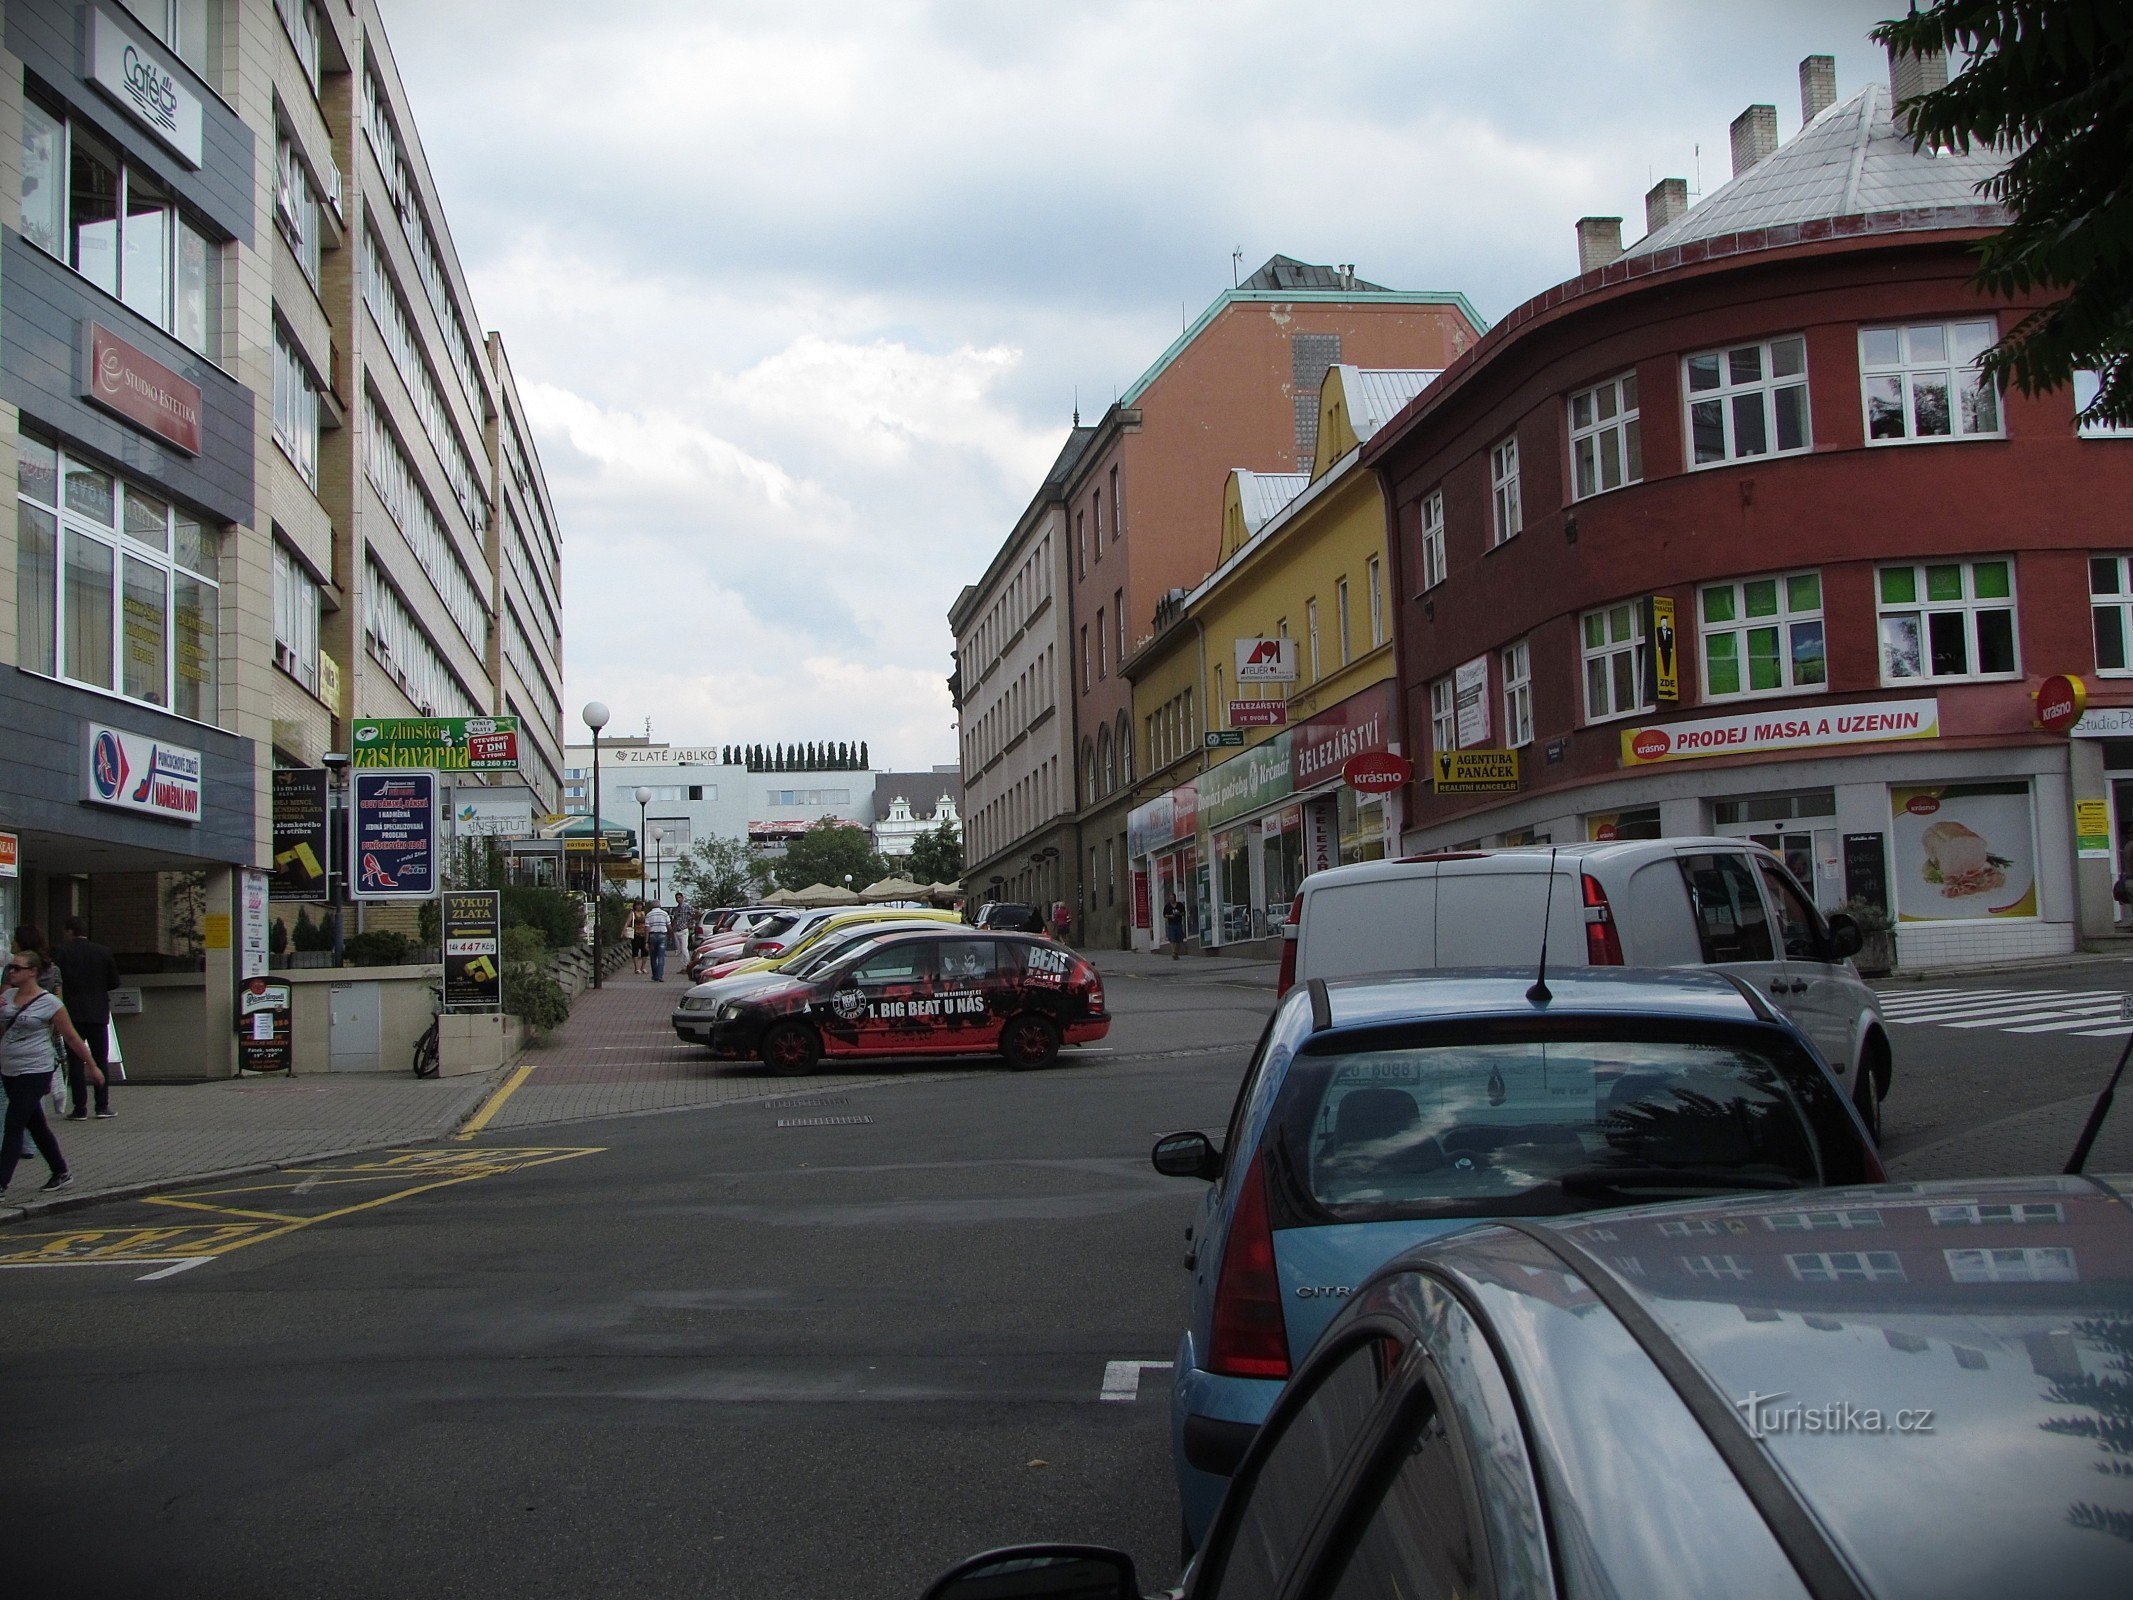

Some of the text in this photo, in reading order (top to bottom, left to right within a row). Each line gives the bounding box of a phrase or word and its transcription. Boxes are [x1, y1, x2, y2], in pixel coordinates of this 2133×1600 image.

[124, 45, 160, 105] Café
[125, 368, 158, 401] STUDIO
[160, 389, 196, 426] ESTETIKA
[1660, 679, 1676, 687] ZDE
[1231, 701, 1285, 710] ŽELEZÁŘSTVÍ
[2042, 701, 2071, 721] krásno
[2074, 715, 2119, 731] Studio
[1677, 712, 1919, 750] PRODEJ MASA A UZENIN
[473, 735, 509, 744] OTEVŘENO
[1299, 712, 1379, 777] ŽELEZÁŘSTVÍ
[477, 741, 507, 753] 7 DNÍ
[1637, 742, 1665, 754] krásno
[354, 740, 469, 768] zastavárna
[631, 749, 718, 761] ZLATÉ JABLKO
[1457, 754, 1513, 765] AGENTURA
[1354, 771, 1402, 784] krásno
[1457, 765, 1514, 778] PANÁČEK
[1440, 781, 1517, 792] REALITNÍ KANCELÁŘ
[1911, 804, 1936, 812] krásno
[365, 822, 424, 831] JEDINÁ SPECIALIZOVANÁ
[382, 831, 408, 839] PRODEJNA
[450, 897, 493, 908] VÝKUP
[452, 909, 492, 919] ZLATA
[449, 943, 459, 951] 14k
[460, 942, 481, 952] 447
[1028, 946, 1069, 974] BEAT
[868, 1003, 879, 1019] 1.
[881, 1002, 905, 1018] BIG
[908, 1000, 941, 1016] BEAT
[945, 999, 954, 1014] U
[957, 995, 985, 1014] NÁS
